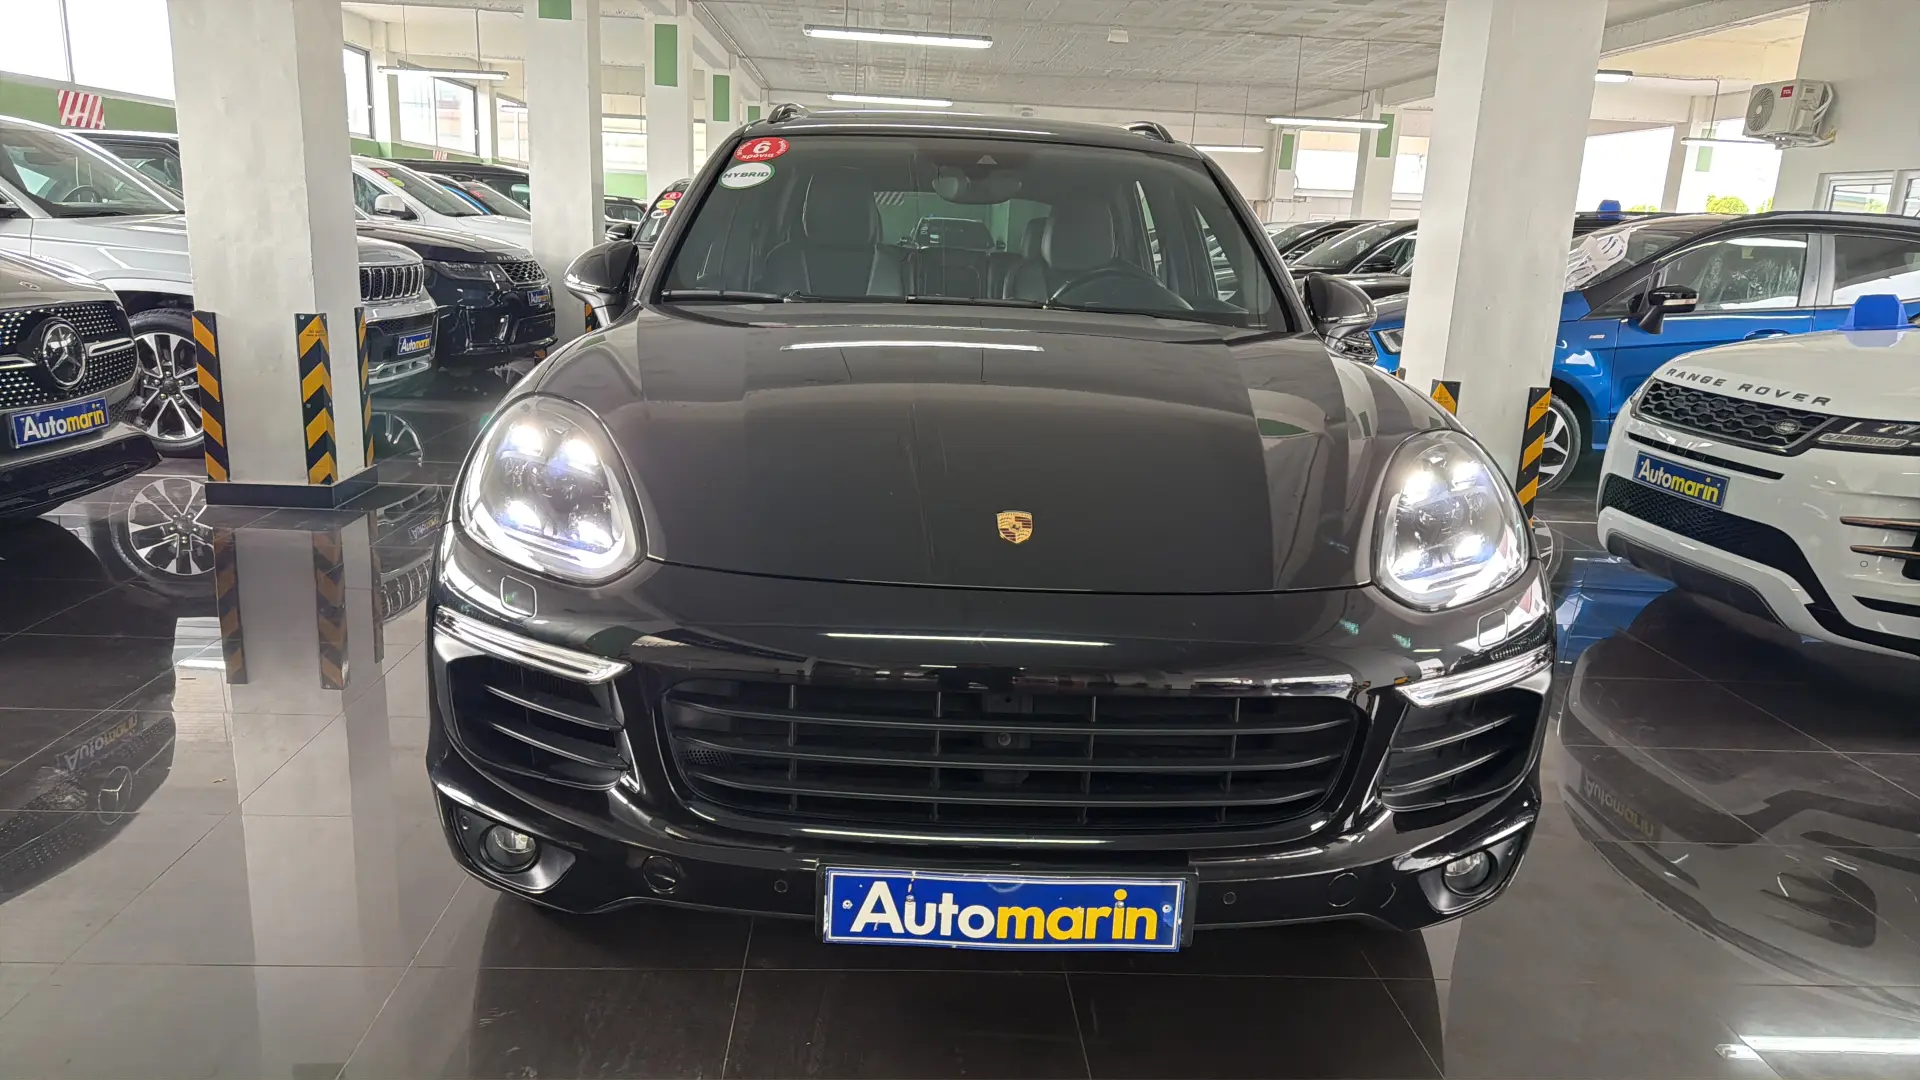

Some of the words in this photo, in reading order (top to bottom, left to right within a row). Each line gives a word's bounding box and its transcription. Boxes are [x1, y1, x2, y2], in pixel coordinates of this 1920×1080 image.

[752, 141, 772, 154] 6
[722, 171, 769, 179] HYBRID
[1666, 368, 1727, 387] RANGE
[1737, 383, 1832, 407] ROVER
[23, 403, 105, 442] Automarin
[1638, 458, 1719, 503] Automarin
[850, 880, 1158, 941] Automarin
